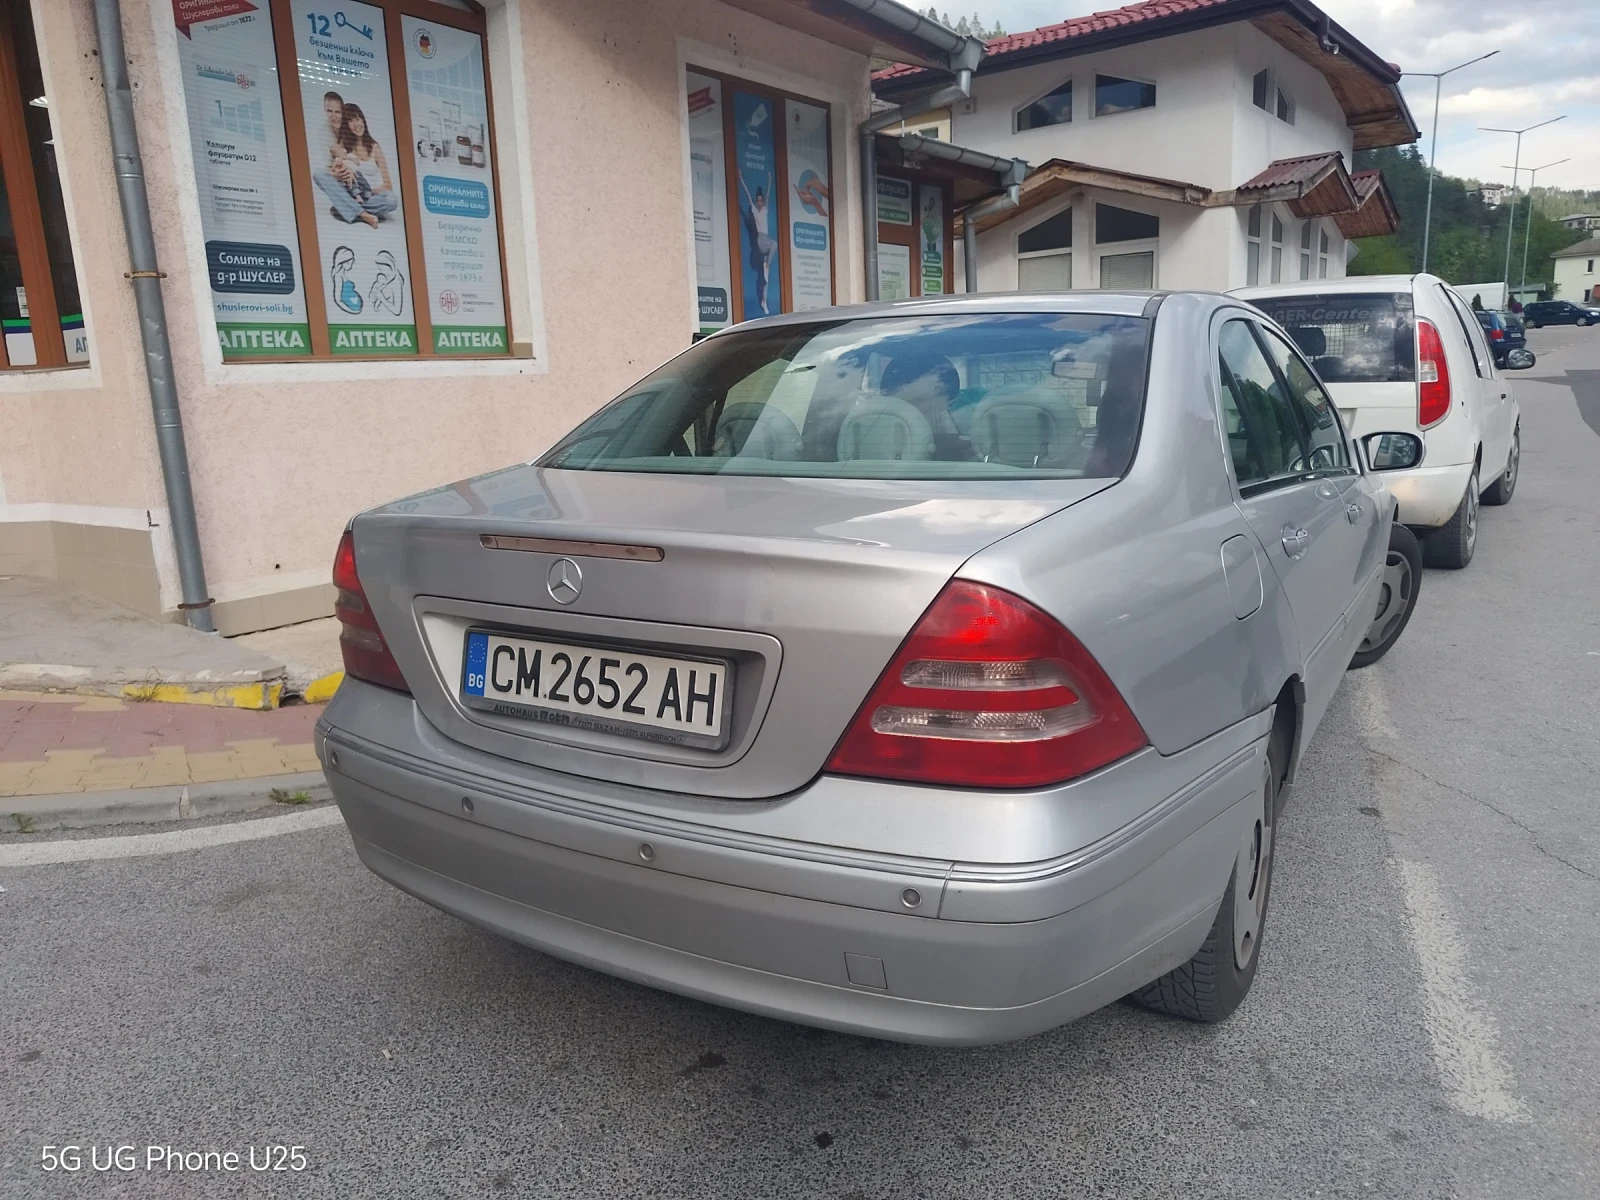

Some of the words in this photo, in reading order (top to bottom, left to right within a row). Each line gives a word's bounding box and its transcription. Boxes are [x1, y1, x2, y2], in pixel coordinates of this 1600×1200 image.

[182, 6, 223, 20] Шуслерови
[239, 15, 252, 24] 1873
[307, 13, 332, 37] 12
[309, 36, 349, 54] безценни
[349, 45, 375, 59] ключа
[317, 50, 335, 62] към
[335, 54, 370, 69] Вашето
[244, 154, 257, 162] D12
[428, 184, 485, 199] ОРИГИНАЛНИТЕ
[429, 196, 469, 209] Шуслерови
[218, 252, 265, 266] Солите
[267, 257, 281, 266] на
[217, 271, 237, 285] д-р
[239, 270, 287, 284] ШУСЛЕР
[459, 273, 477, 282] 1873
[217, 302, 294, 315] shuslerovi-soli.bg
[218, 330, 305, 348] АПТЕКА
[335, 331, 412, 347] АПТЕКА
[438, 332, 503, 347] АПТЕКА
[468, 672, 484, 689] BG
[656, 667, 718, 727] AH
[494, 704, 538, 719] AUTOHAUS
